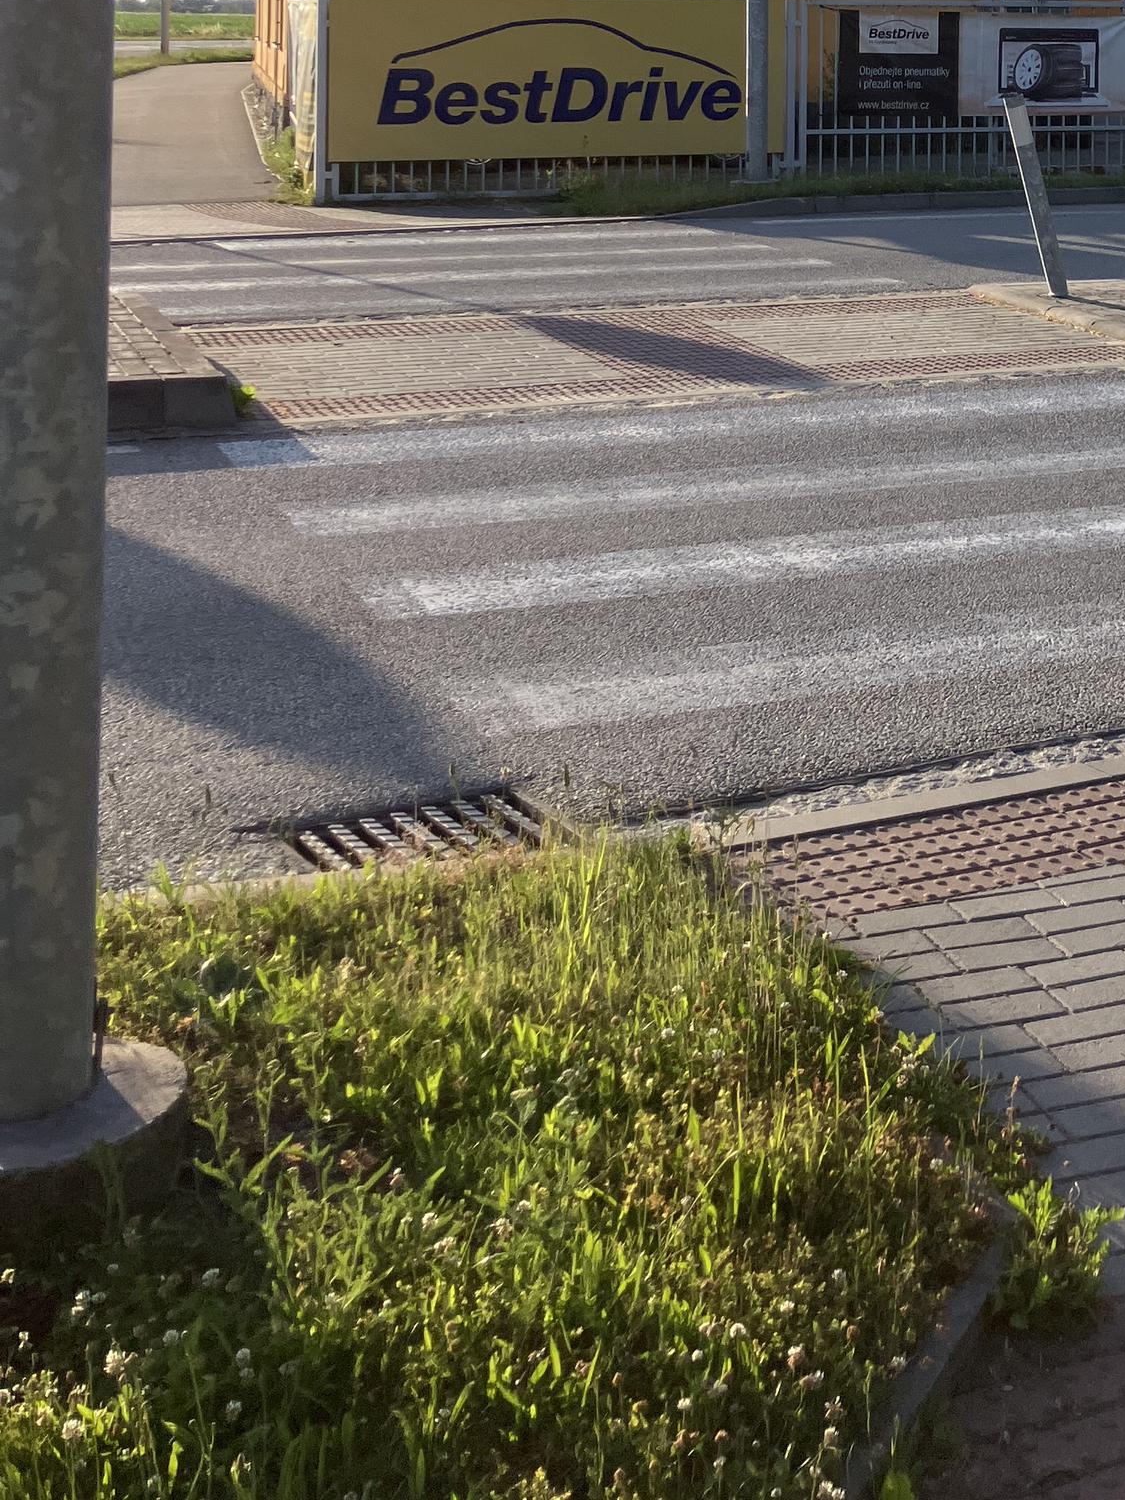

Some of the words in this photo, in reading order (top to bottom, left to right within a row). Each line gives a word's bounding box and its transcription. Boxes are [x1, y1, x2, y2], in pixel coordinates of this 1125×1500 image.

[869, 28, 930, 40] BestDrive
[859, 65, 903, 78] Objednejte
[904, 66, 950, 78] pneumatiky
[377, 67, 742, 125] BestDrive
[858, 99, 930, 110] www.bestdrive.cz
